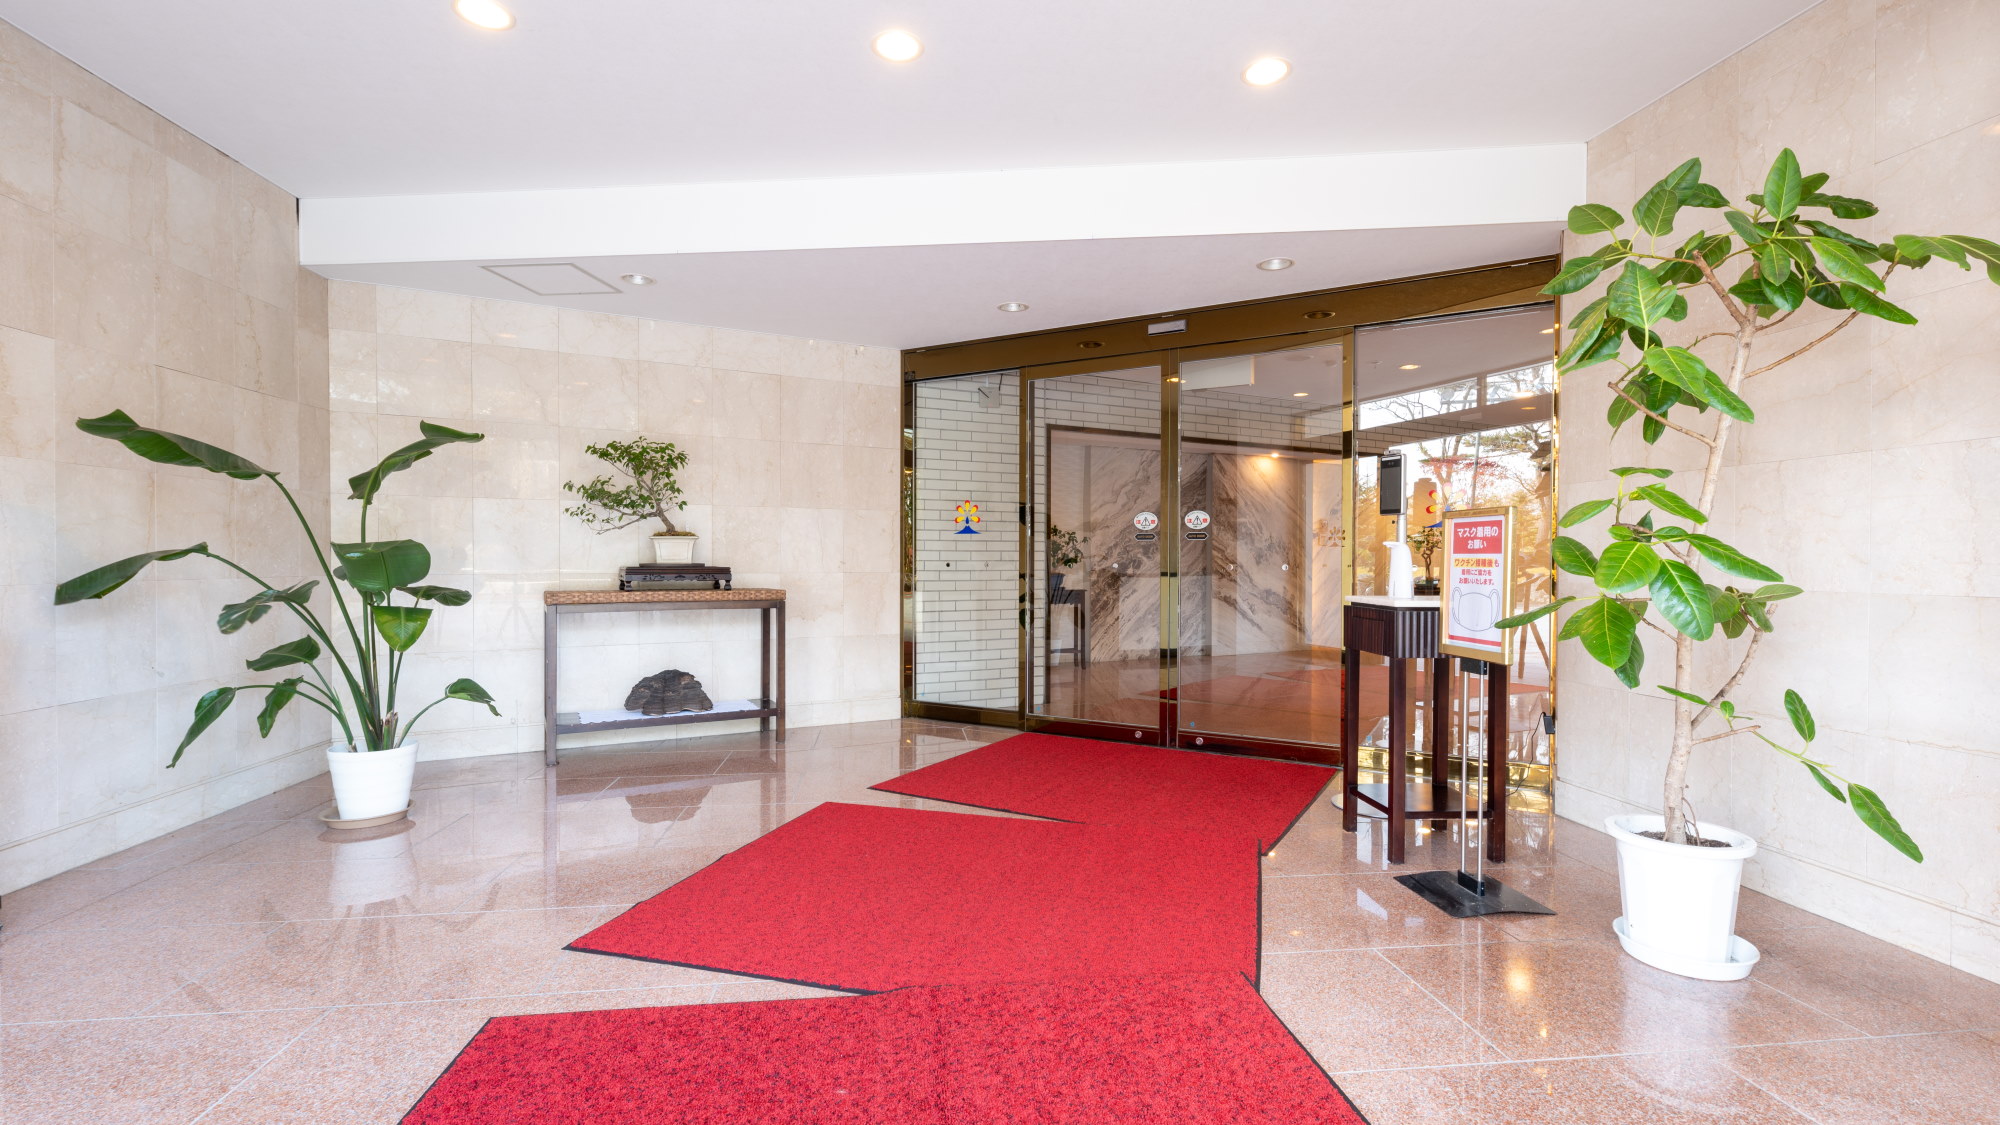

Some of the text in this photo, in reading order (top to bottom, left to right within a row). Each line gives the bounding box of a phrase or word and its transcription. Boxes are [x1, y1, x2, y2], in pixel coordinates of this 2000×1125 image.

[1457, 526, 1499, 538] マスク着用の
[1467, 539, 1487, 549] お願い
